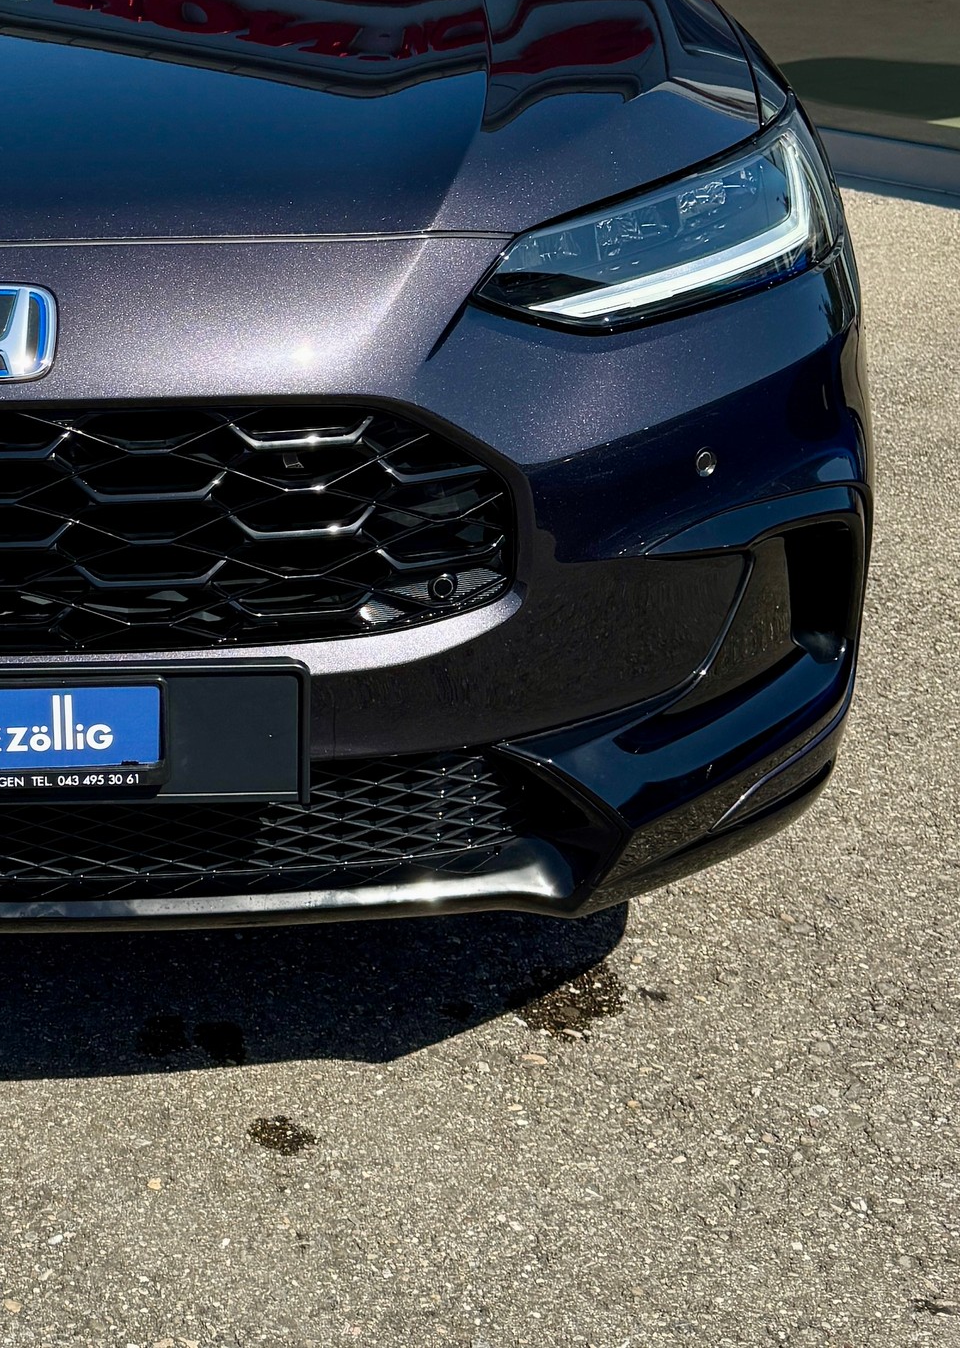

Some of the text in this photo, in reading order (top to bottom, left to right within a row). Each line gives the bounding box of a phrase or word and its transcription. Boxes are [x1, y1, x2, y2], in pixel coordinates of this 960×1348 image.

[30, 775, 53, 787] TEL.
[57, 775, 80, 787] 043
[82, 774, 105, 786] 495
[108, 773, 123, 786] 30
[126, 773, 140, 785] 61
